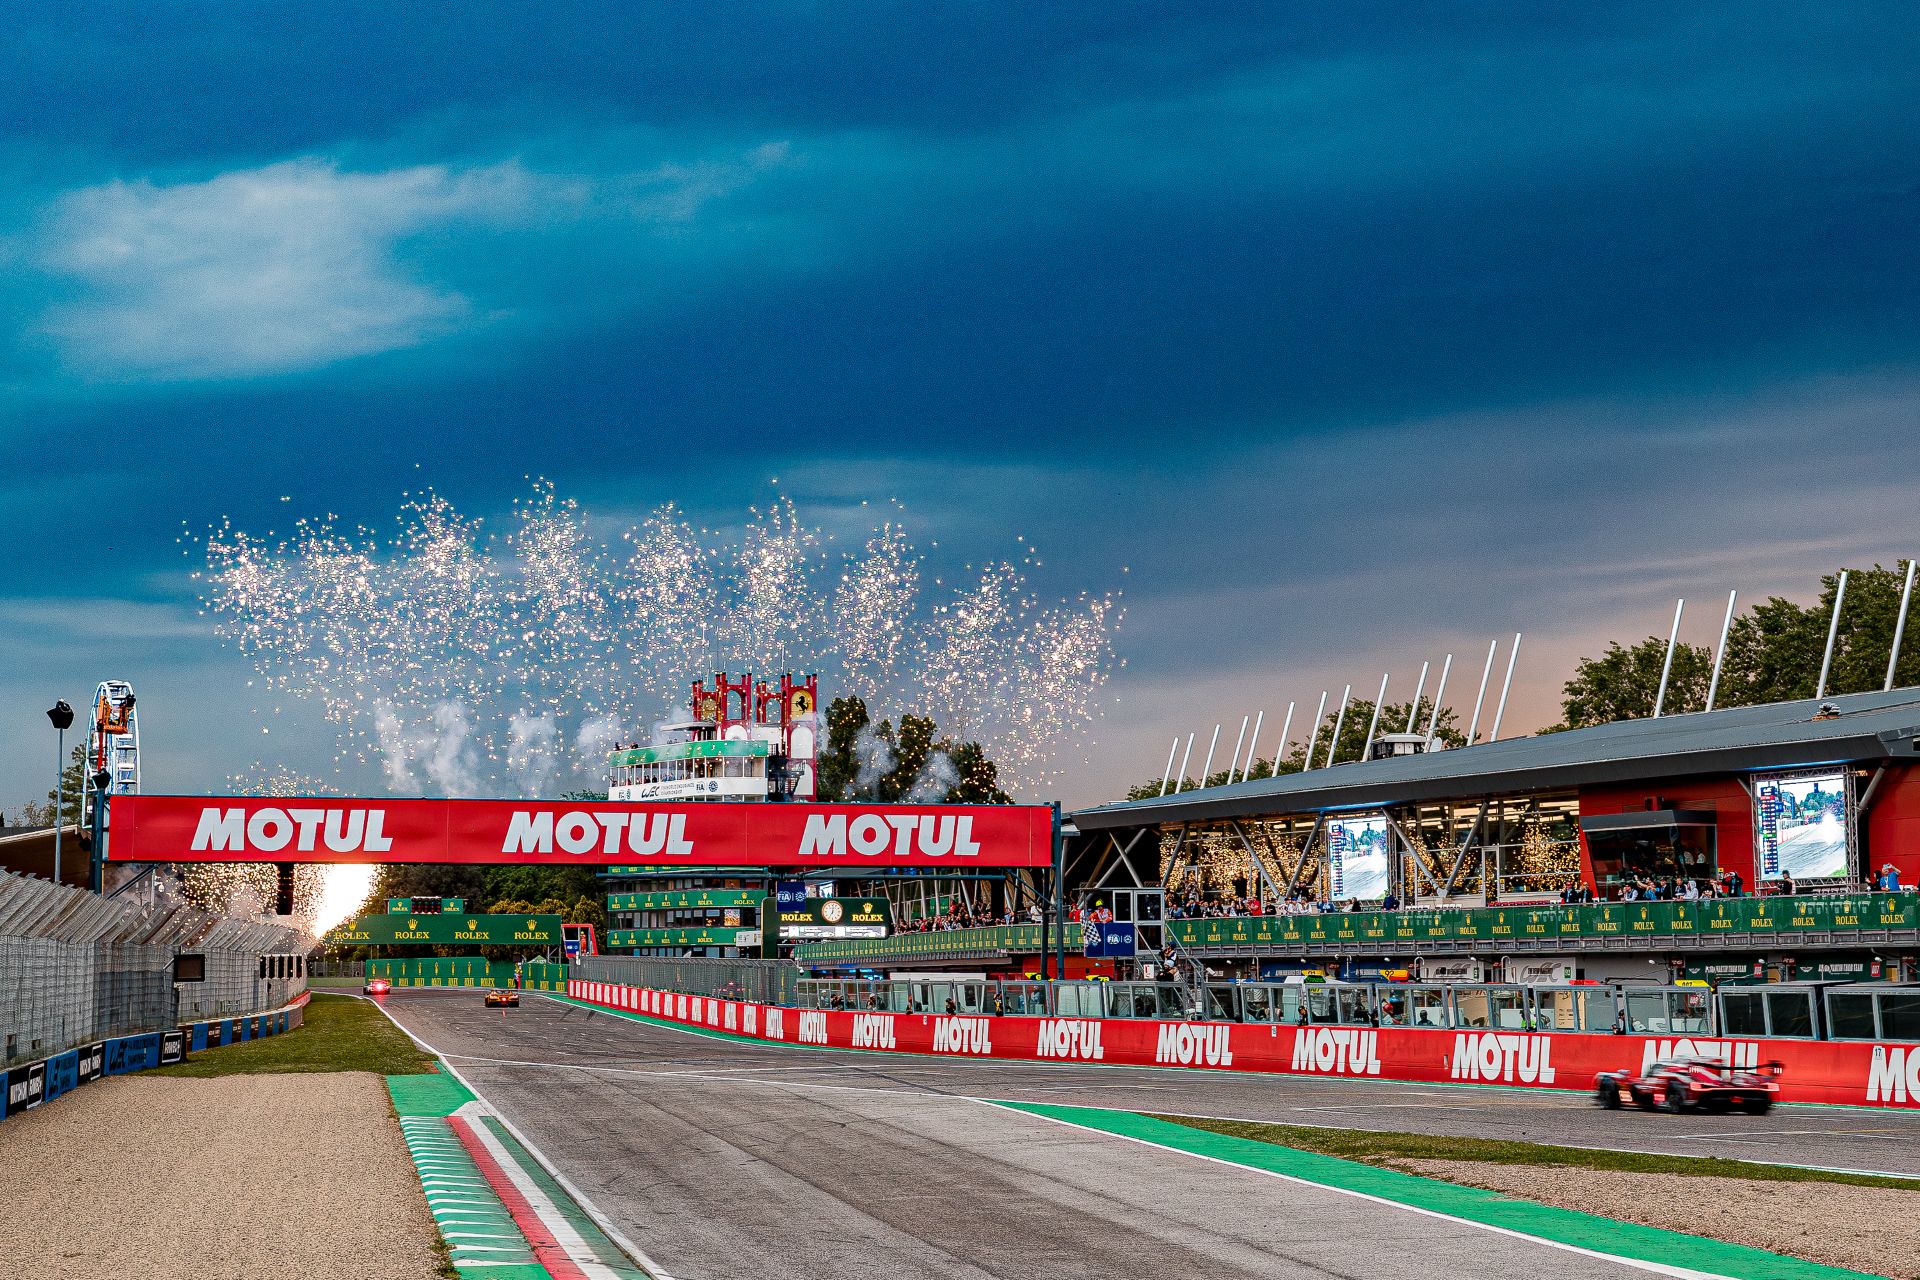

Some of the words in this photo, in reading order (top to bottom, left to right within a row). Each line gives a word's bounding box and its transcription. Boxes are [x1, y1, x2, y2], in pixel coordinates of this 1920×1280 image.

[190, 807, 393, 852] MOTUL
[501, 812, 694, 855] MOTUL
[798, 814, 981, 857] MOTUL
[334, 931, 370, 940] ROLEX
[394, 931, 430, 940] ROLEX
[454, 931, 489, 940] ROLEX
[514, 931, 549, 940] ROLEX
[781, 914, 813, 922] ROLEX
[852, 914, 884, 922] ROLEX
[1397, 928, 1414, 937] ROLEX
[1428, 927, 1446, 936] ROLEX
[1459, 926, 1477, 935] ROLEX
[1492, 925, 1511, 934] ROLEX
[1526, 924, 1545, 933] ROLEX
[1561, 923, 1580, 932] ROLEX
[1597, 922, 1617, 931] ROLEX
[1633, 921, 1655, 930] ROLEX
[1671, 920, 1692, 929] ROLEX
[1711, 919, 1732, 929] ROLEX
[1751, 918, 1773, 927] ROLEX
[1792, 917, 1815, 926] ROLEX
[1835, 915, 1858, 925] ROLEX
[1880, 914, 1904, 924] ROLEX
[799, 1011, 828, 1044] MOTUL
[852, 1013, 896, 1049] MOTUL
[932, 1016, 992, 1054] MOTUL
[1036, 1019, 1104, 1059] MOTUL
[1155, 1023, 1232, 1066] MOTUL
[1291, 1028, 1381, 1074] MOTUL
[1451, 1032, 1556, 1084] MOTUL
